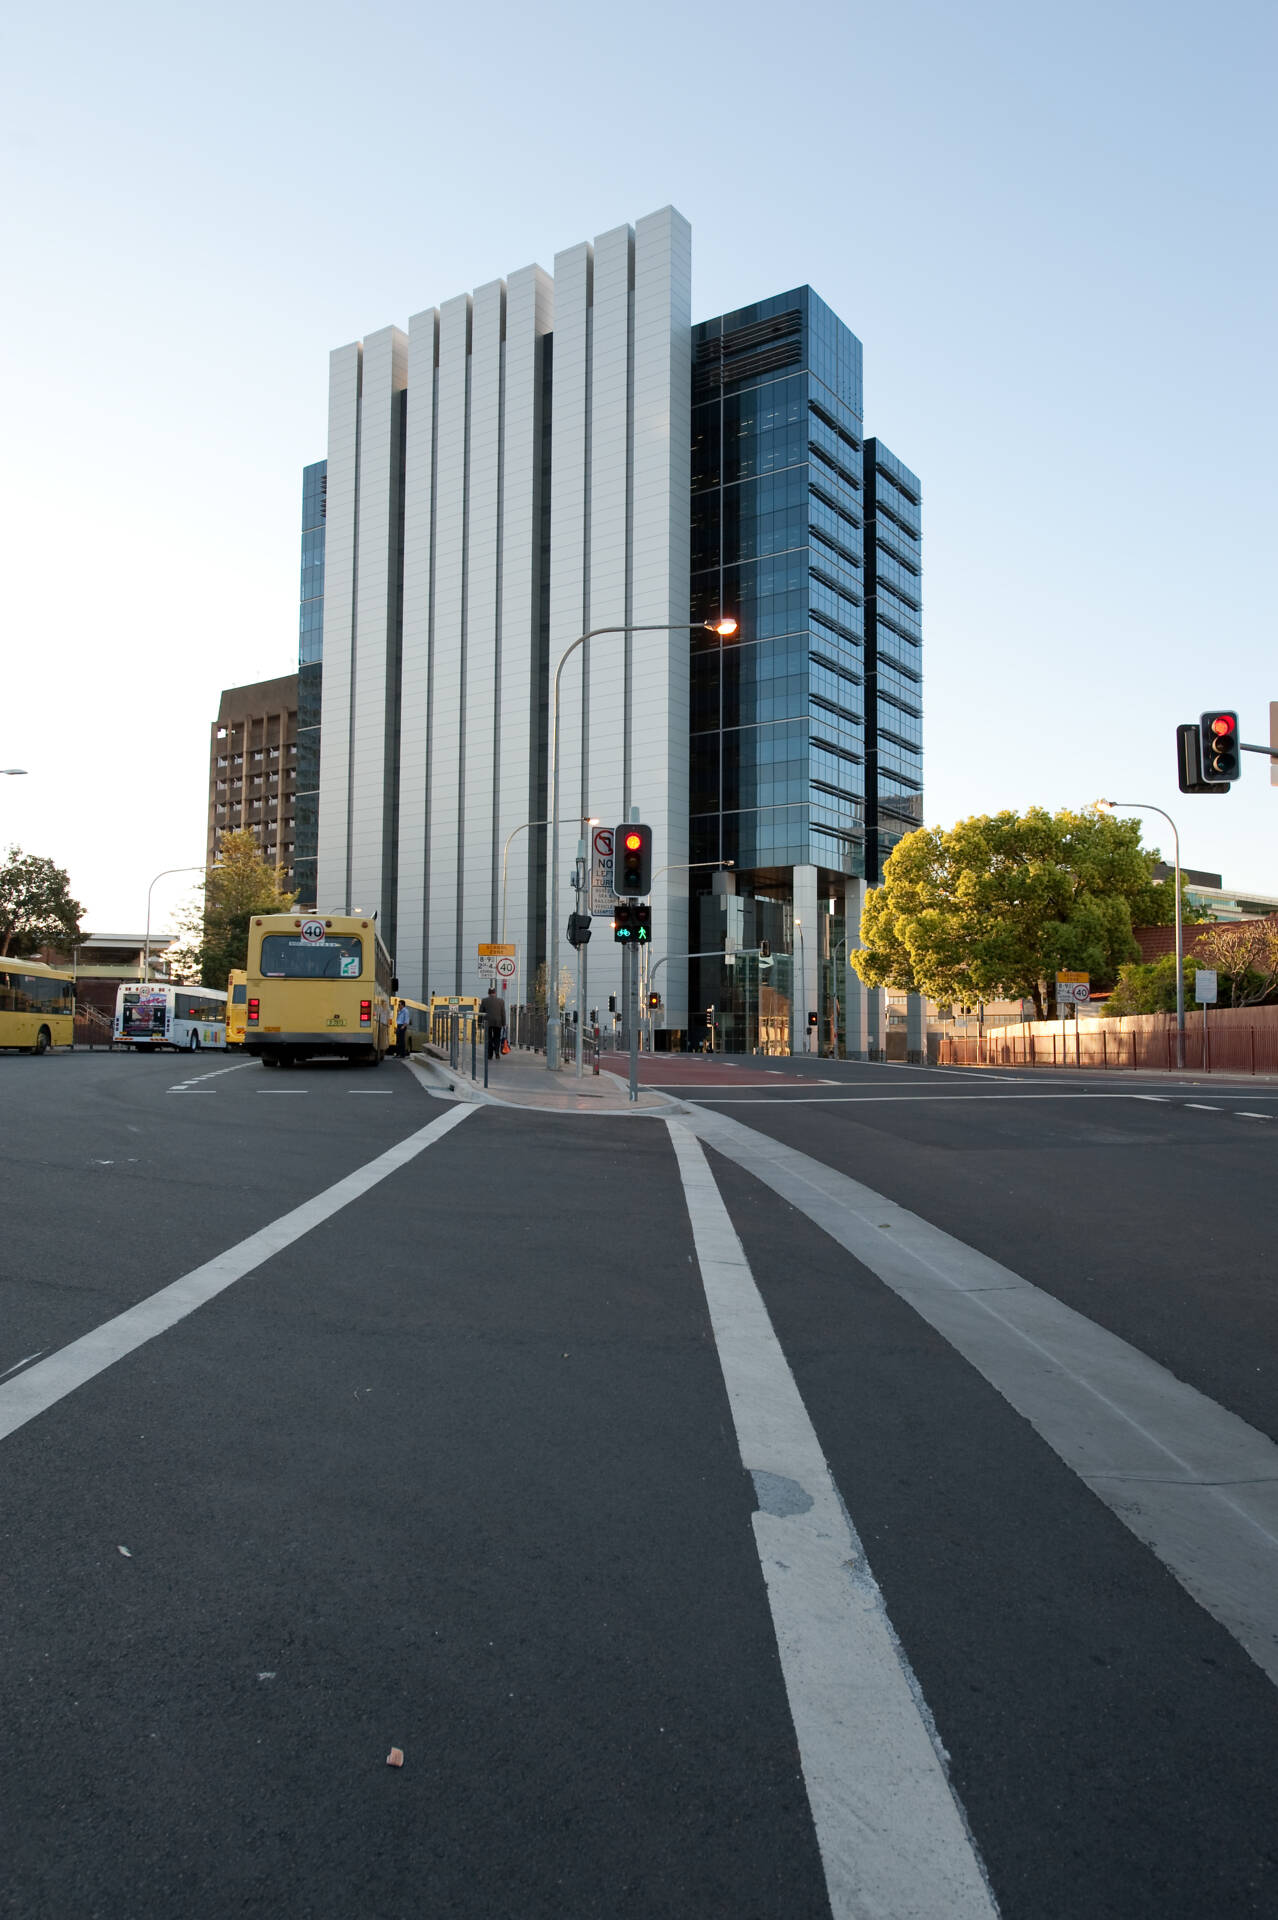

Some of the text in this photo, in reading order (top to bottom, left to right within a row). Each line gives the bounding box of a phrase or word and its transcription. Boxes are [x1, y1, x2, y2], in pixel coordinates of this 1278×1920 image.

[598, 859, 613, 868] NO
[304, 926, 322, 937] 40
[500, 963, 512, 972] 40
[1076, 989, 1087, 997] 40
